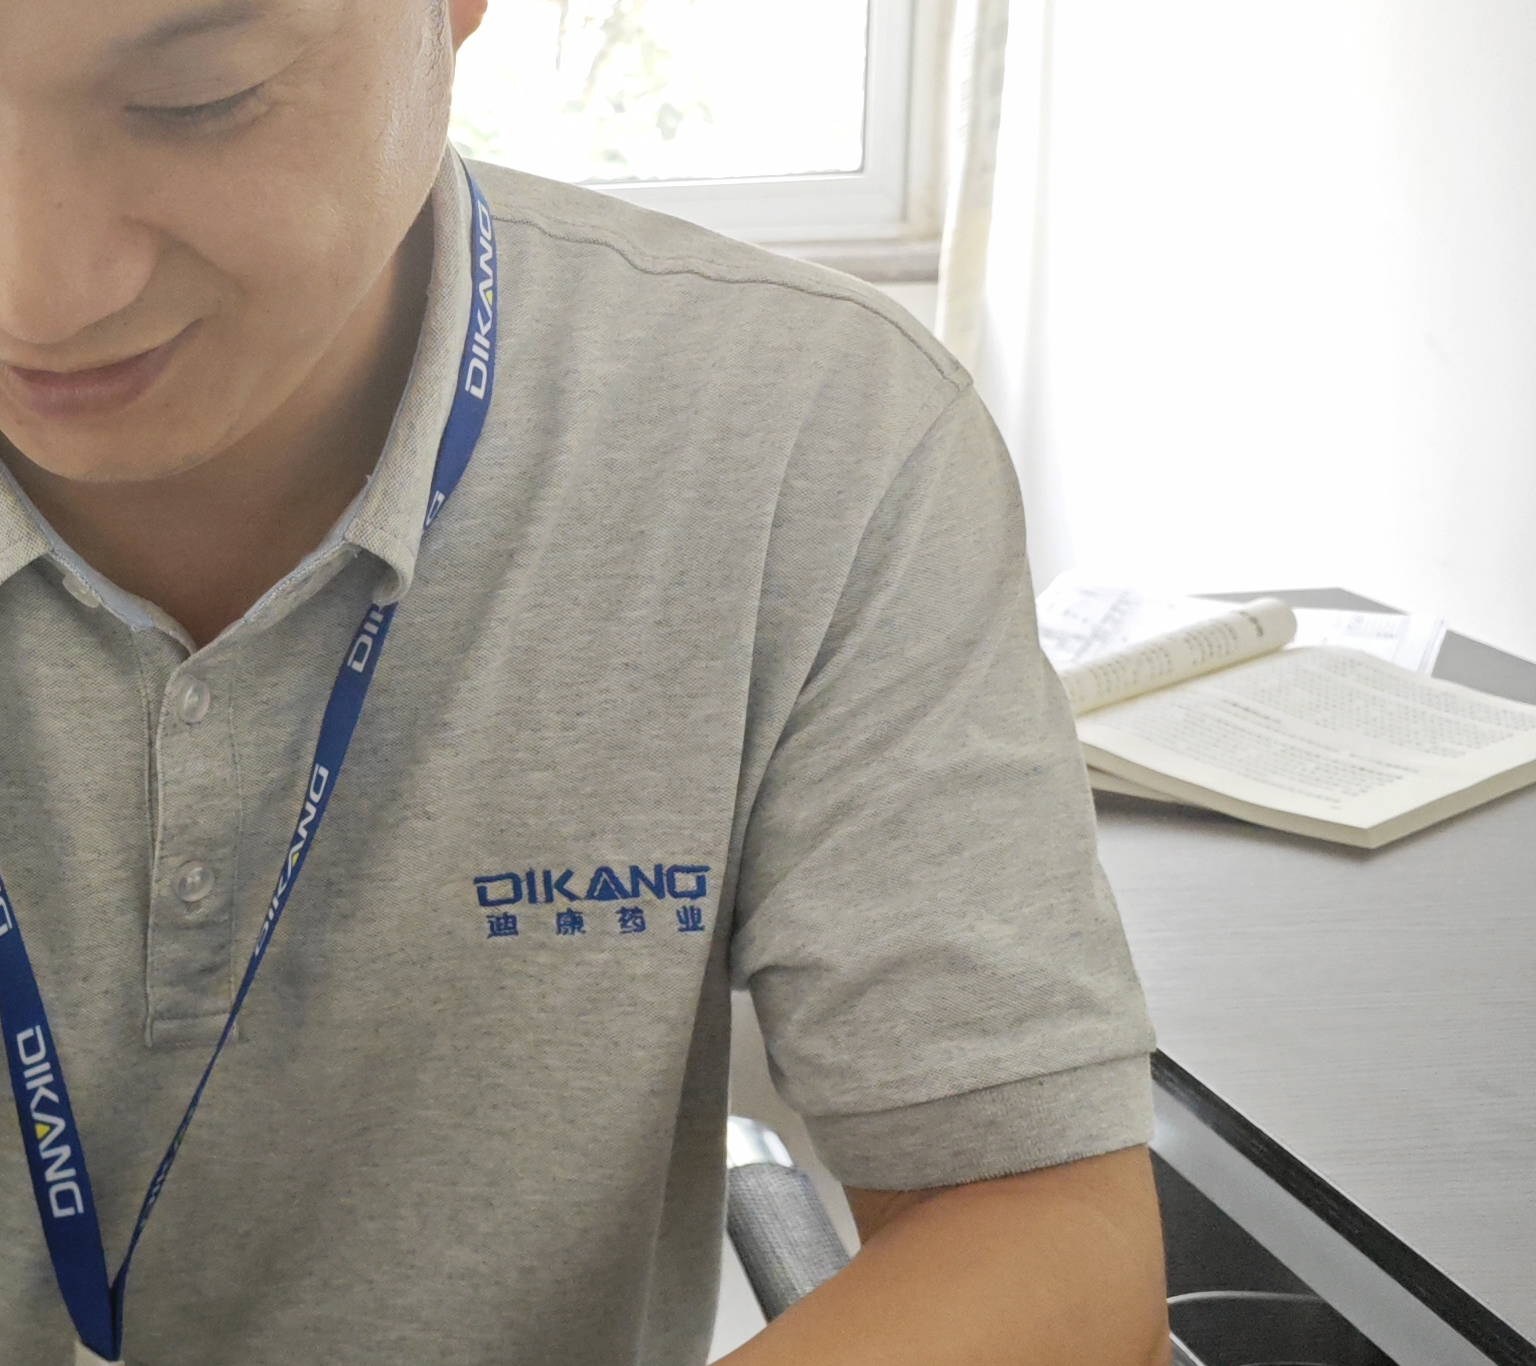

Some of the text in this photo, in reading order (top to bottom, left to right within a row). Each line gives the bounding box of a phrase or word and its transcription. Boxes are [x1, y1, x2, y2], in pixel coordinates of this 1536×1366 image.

[465, 198, 495, 400] DIKANG
[473, 863, 711, 907] DIKANG
[486, 905, 705, 940] 迪康药业
[16, 1024, 84, 1219] DIKANG
